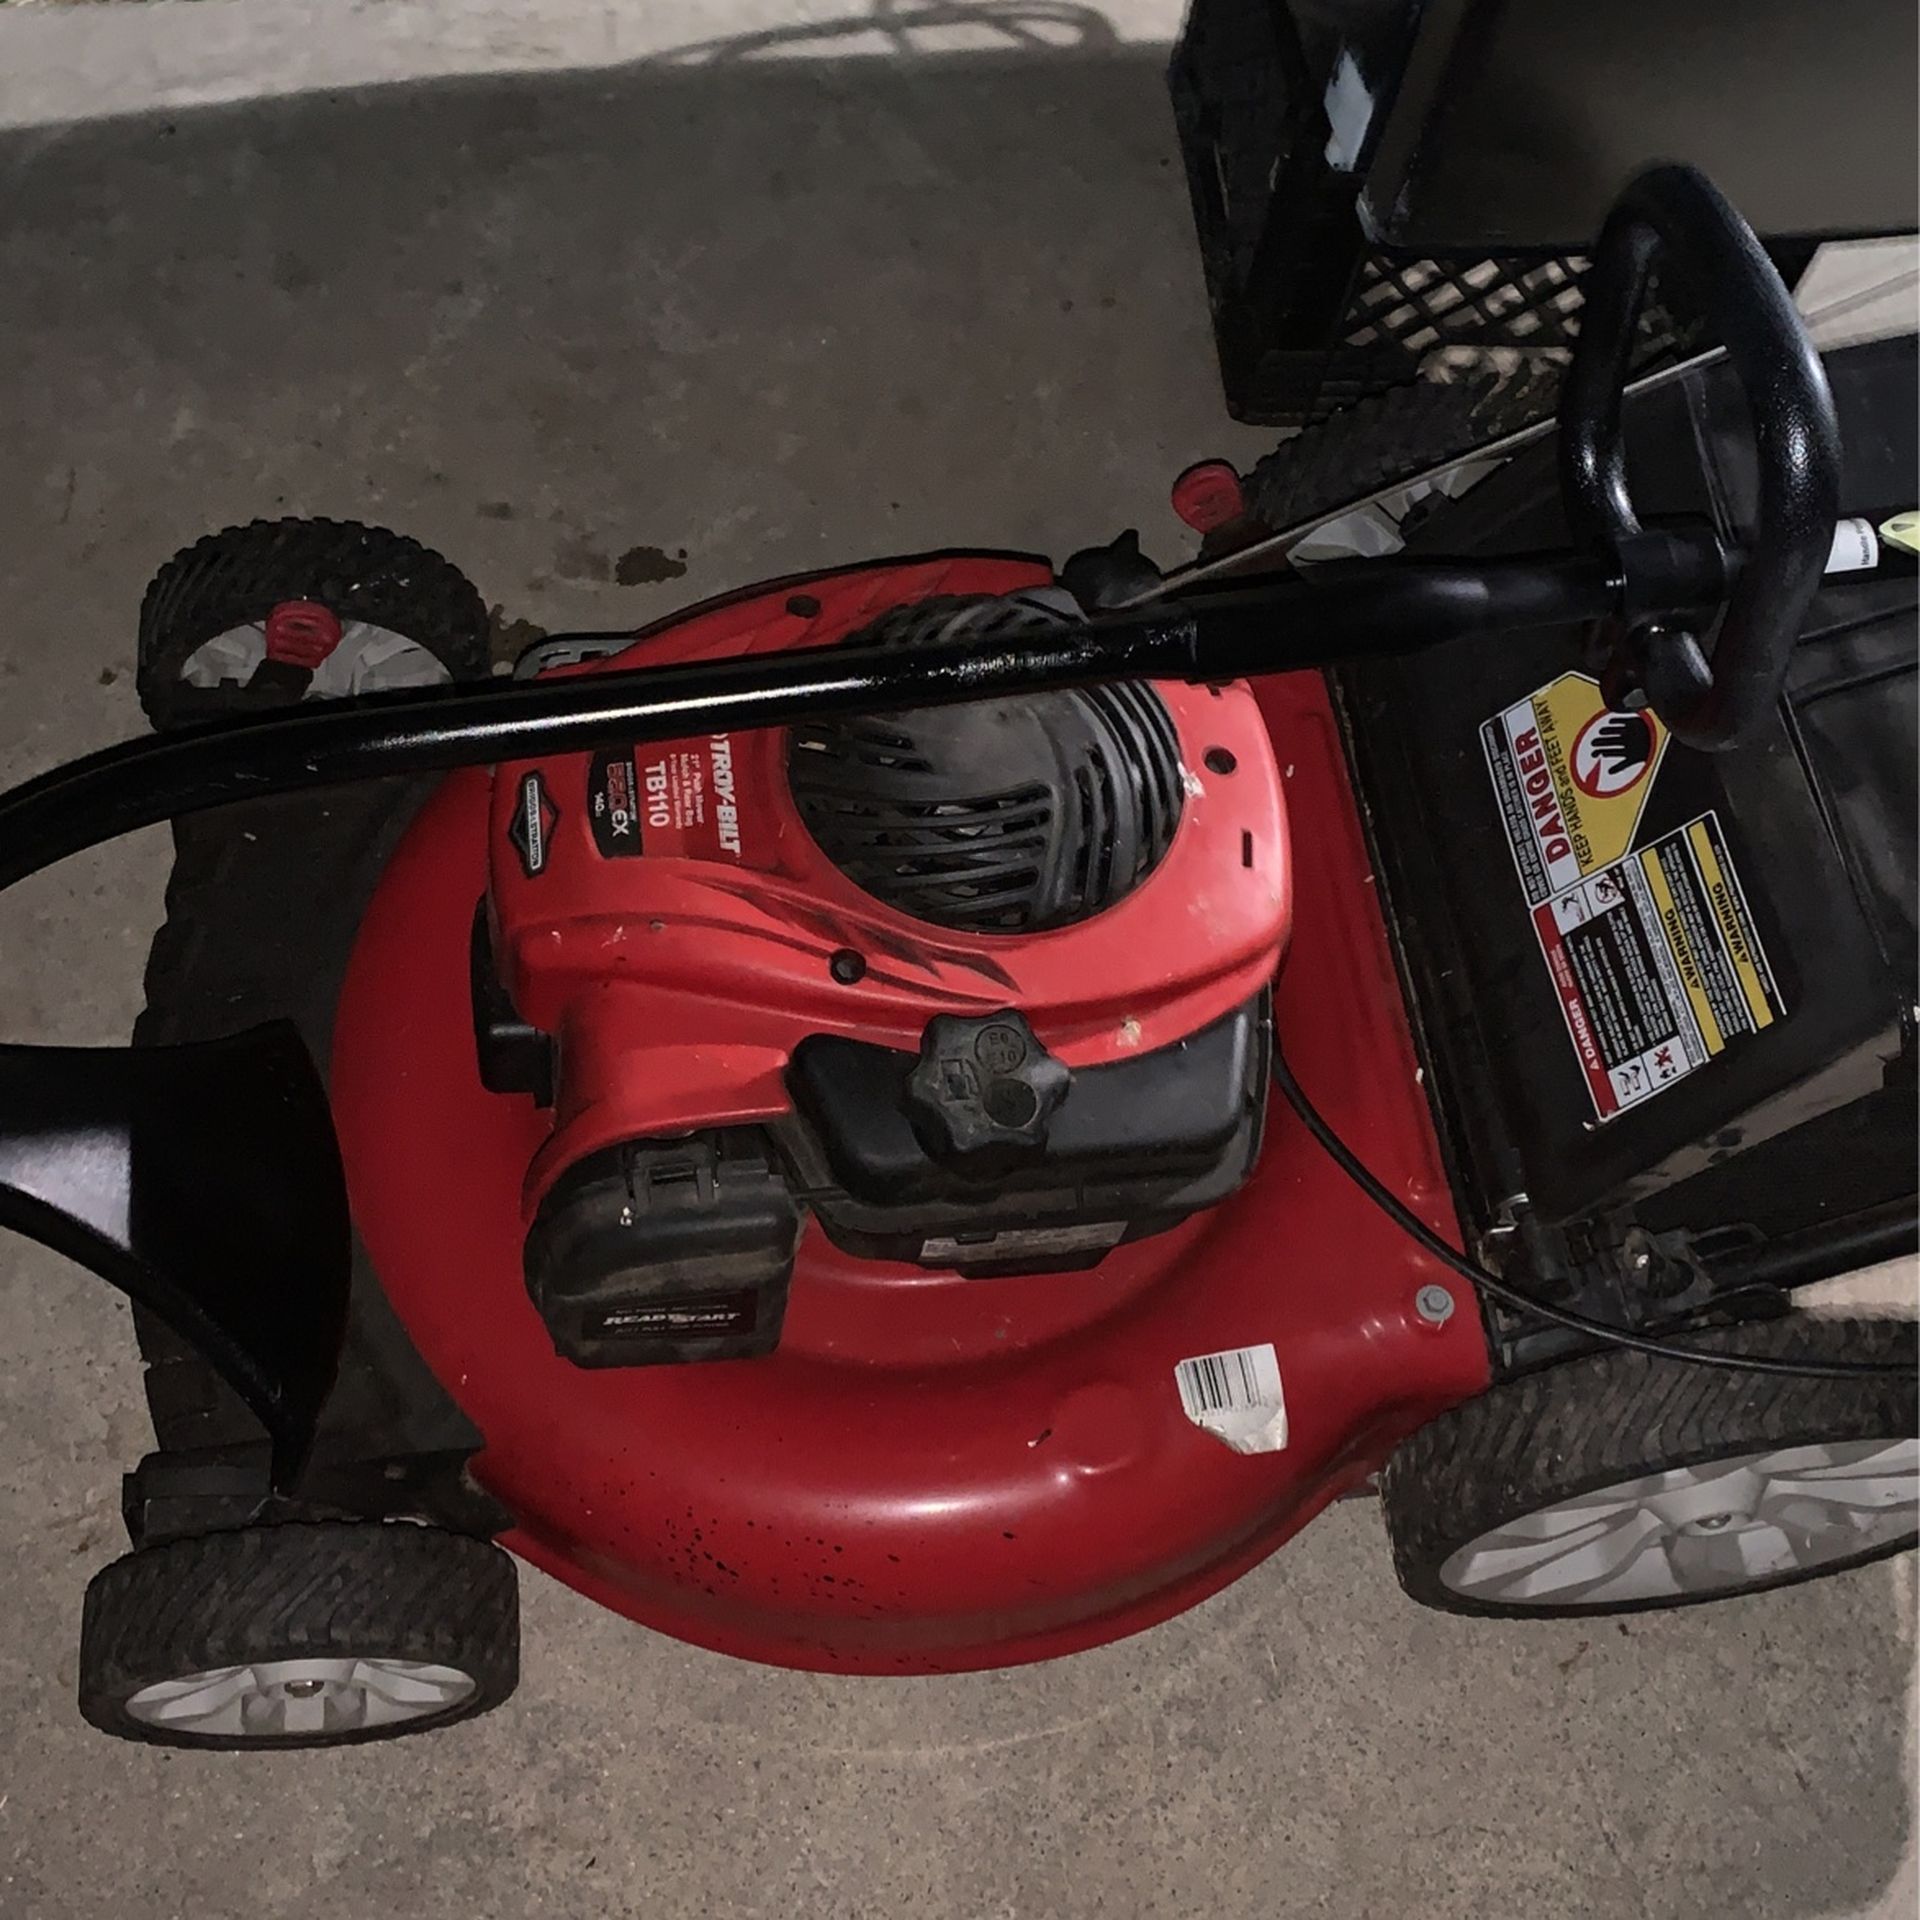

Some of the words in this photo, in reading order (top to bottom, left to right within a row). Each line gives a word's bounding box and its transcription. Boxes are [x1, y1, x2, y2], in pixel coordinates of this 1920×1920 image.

[1535, 699, 1555, 734] AWAY
[1544, 735, 1563, 766] FEET
[1555, 764, 1570, 787] and
[643, 760, 670, 828] TB110
[710, 740, 740, 855] TROY-BILT
[1515, 726, 1571, 865] DANGER
[1561, 787, 1583, 832] HANDS
[1573, 833, 1594, 868] KEEP
[1663, 907, 1696, 981] WARNING
[1710, 881, 1745, 955] WARNING
[1567, 996, 1596, 1060] DANGER
